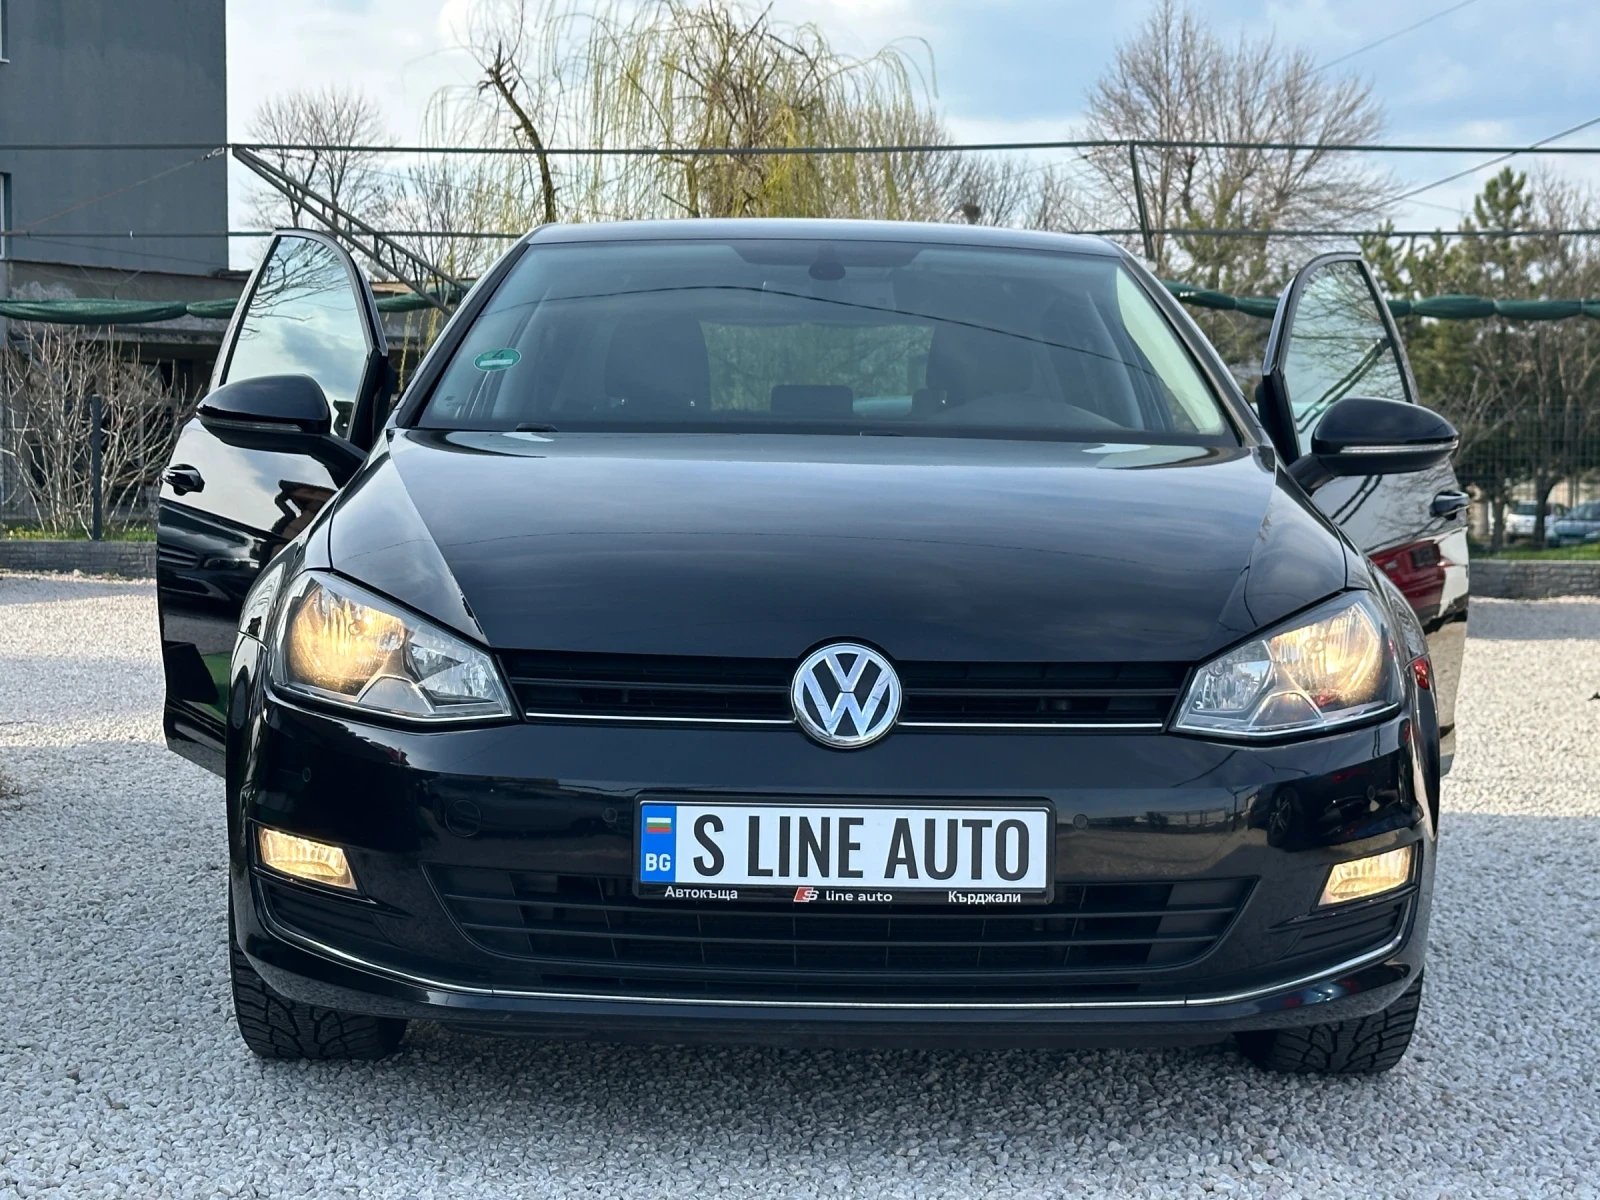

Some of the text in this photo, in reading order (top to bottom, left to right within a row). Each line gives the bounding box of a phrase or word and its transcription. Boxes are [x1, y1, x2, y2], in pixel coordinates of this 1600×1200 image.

[794, 645, 899, 746] VW
[693, 814, 1030, 882] S LINE AUTO
[645, 853, 671, 872] BG
[664, 885, 738, 901] Автокъща
[825, 890, 854, 901] line
[857, 891, 893, 902] auto
[947, 890, 1022, 905] Кърджали
